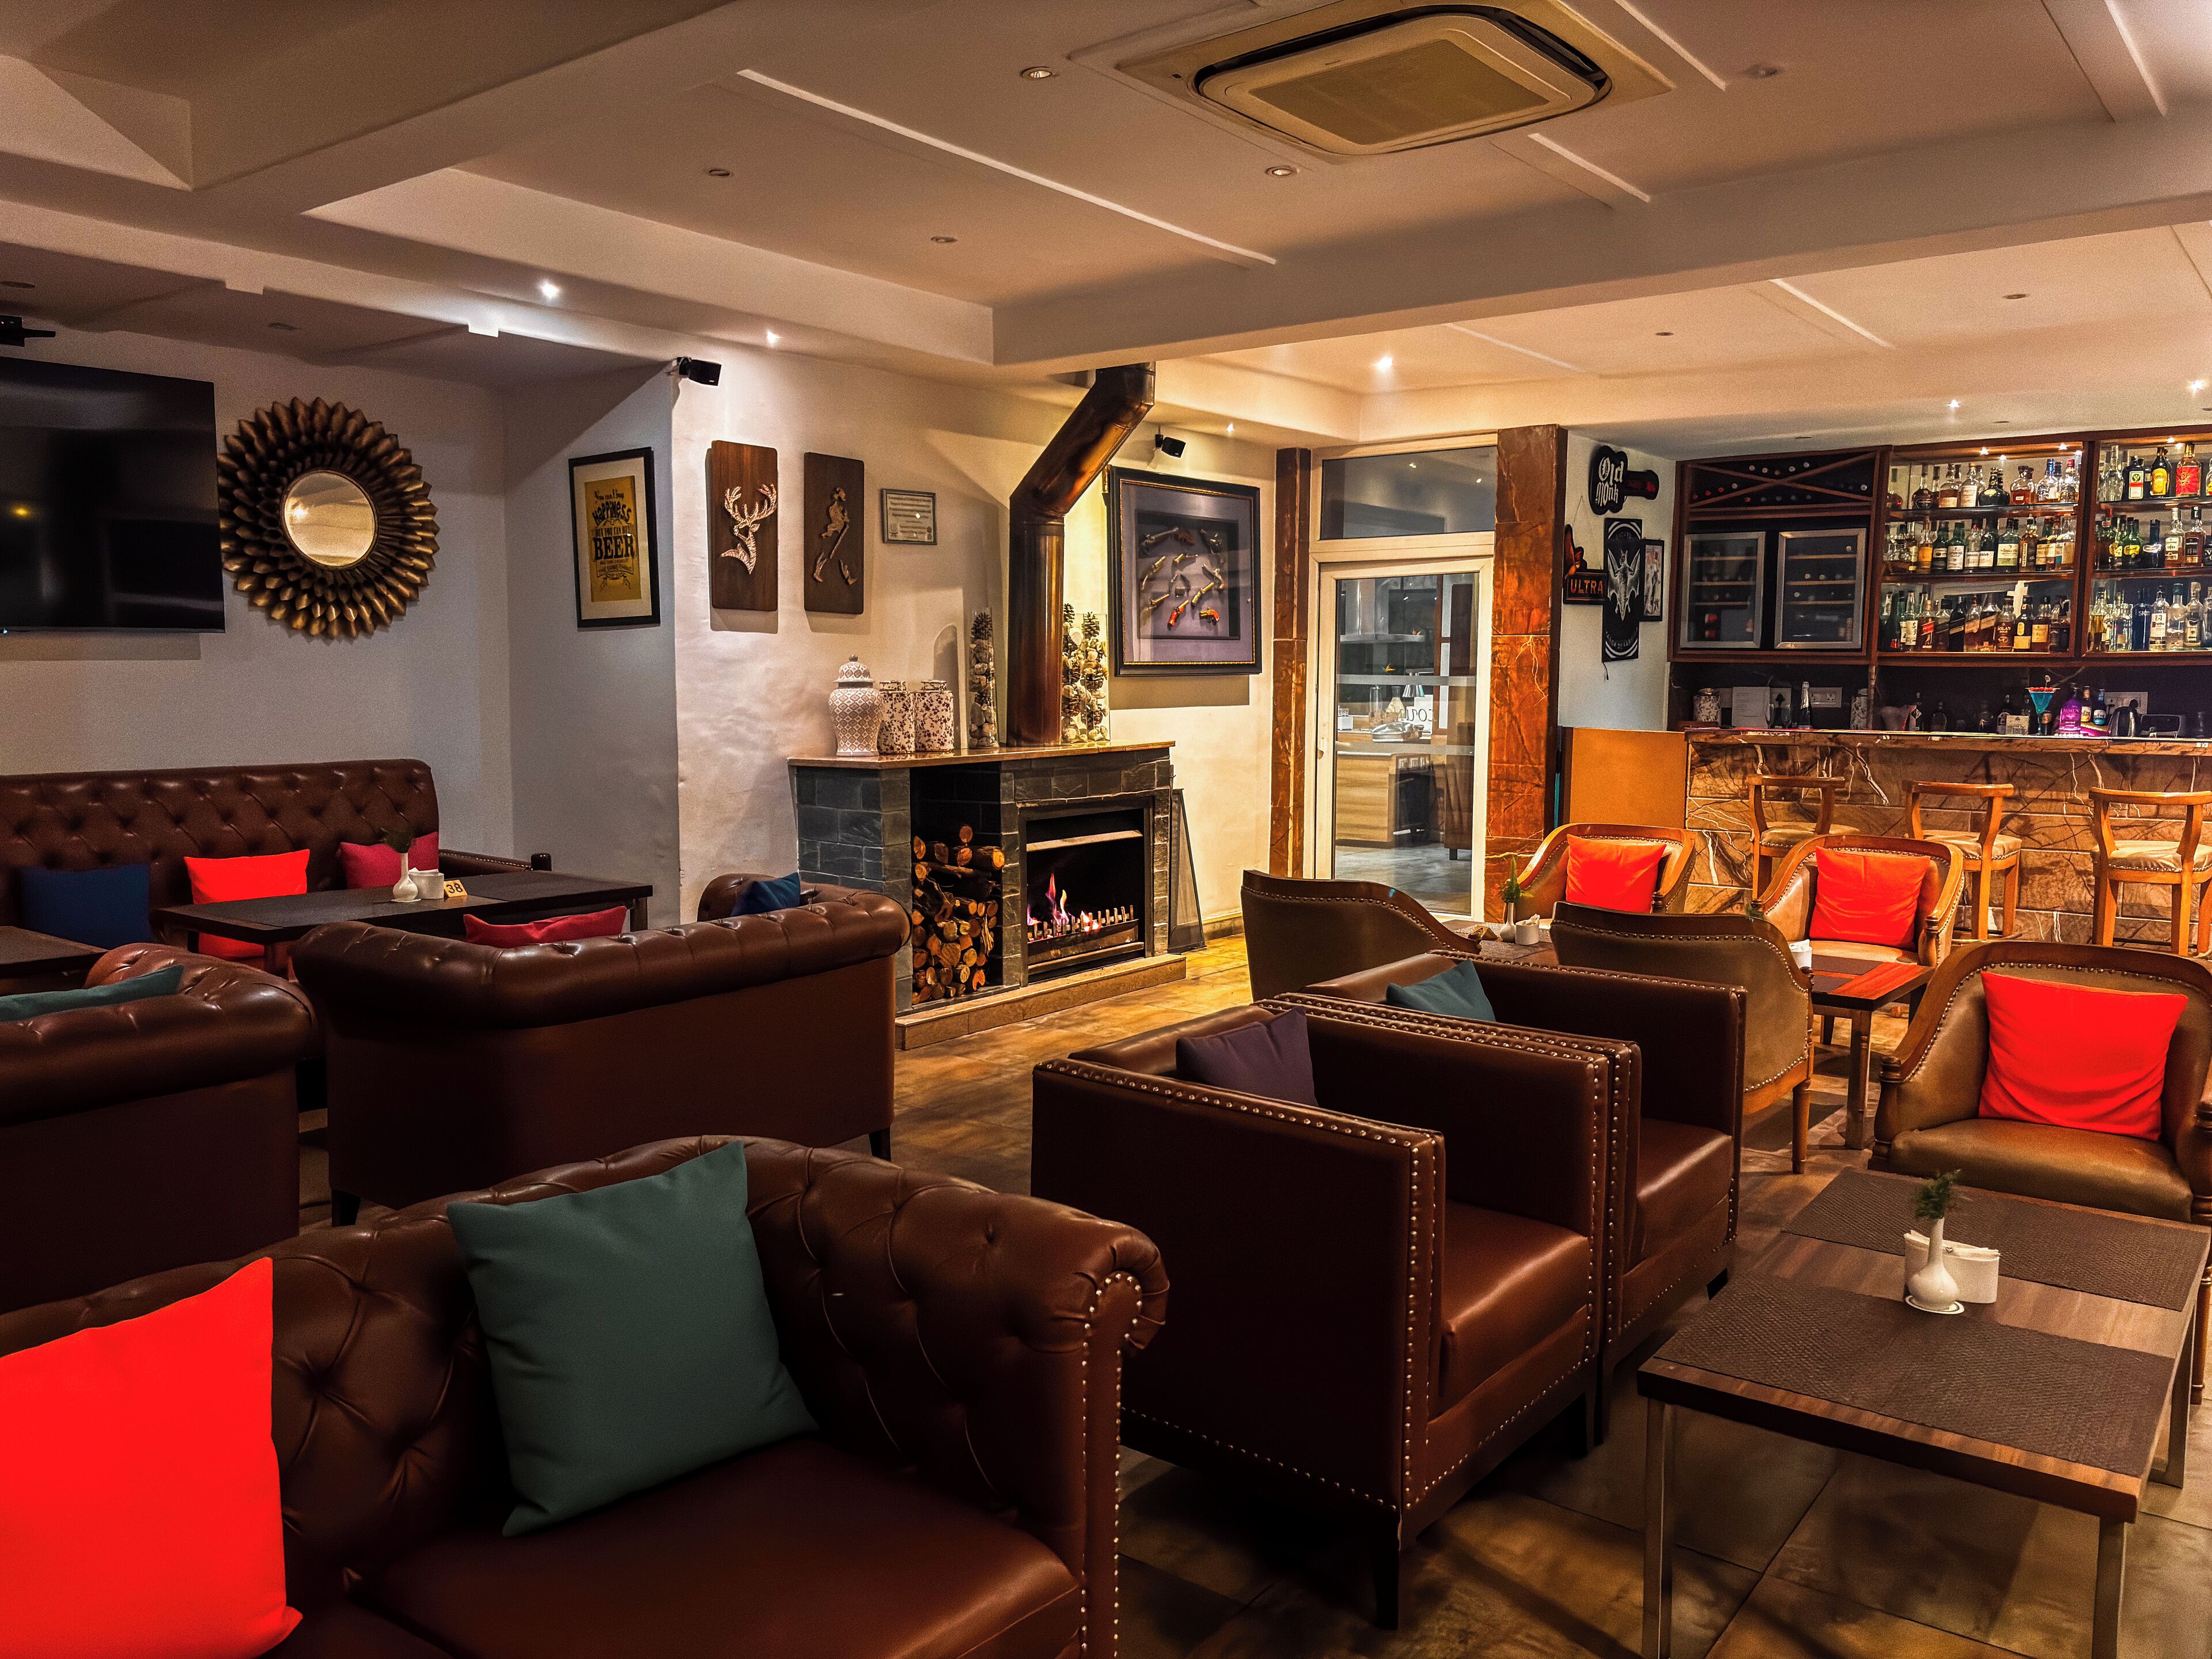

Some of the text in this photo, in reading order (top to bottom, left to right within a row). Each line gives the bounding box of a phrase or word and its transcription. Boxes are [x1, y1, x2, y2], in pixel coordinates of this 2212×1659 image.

[1599, 456, 1624, 486] Old
[1595, 481, 1619, 507] Monk
[593, 535, 635, 560] BEER
[1570, 579, 1603, 594] ULTRA
[446, 883, 463, 894] 38
